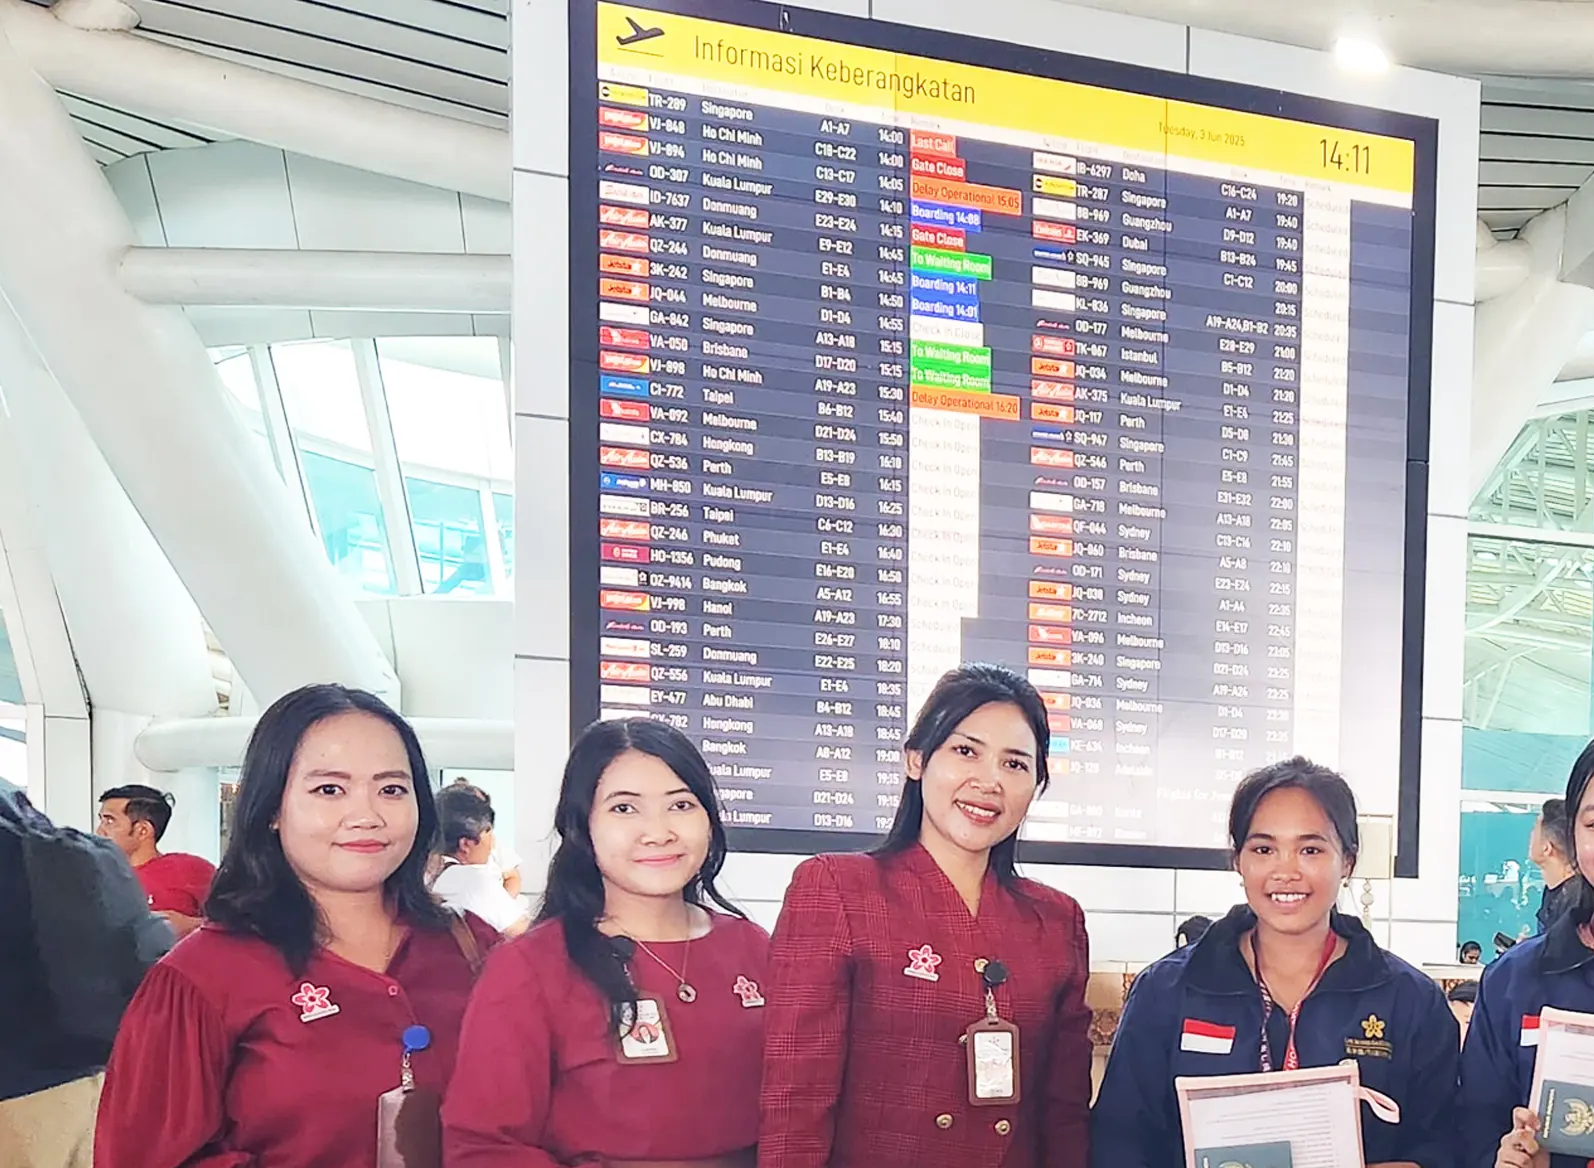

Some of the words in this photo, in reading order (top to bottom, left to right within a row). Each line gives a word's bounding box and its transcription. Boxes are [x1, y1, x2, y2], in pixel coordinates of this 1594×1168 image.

[695, 34, 803, 76] Informasi
[810, 54, 976, 104] Keberangkatan
[701, 100, 753, 121] Singapore
[820, 119, 850, 135] A1-A7
[878, 128, 903, 145] 14:00
[911, 133, 933, 150] Last
[934, 137, 953, 153] Call
[1199, 128, 1205, 140] 3
[1224, 132, 1245, 147] 2025
[702, 124, 717, 139] Ho
[718, 126, 736, 142] Chi
[736, 129, 762, 146] Minh
[878, 151, 903, 168] 14:00
[911, 157, 936, 173] Gate
[936, 161, 964, 177] Close
[1318, 136, 1370, 175] 14:11
[702, 148, 717, 163] Ho
[717, 150, 736, 166] Chi
[736, 153, 762, 170] Minh
[815, 165, 855, 184] C13-C17
[878, 175, 904, 191] 14:05
[912, 181, 939, 198] Delay
[940, 185, 994, 204] Operational
[996, 194, 1019, 209] 15:05
[1122, 167, 1145, 183] Doha
[1276, 191, 1298, 207] 19:20
[702, 172, 732, 189] Kuala
[733, 176, 773, 196] Lumpur
[879, 198, 903, 214] 14:10
[911, 202, 955, 225] Boarding
[955, 210, 980, 226] 14:08
[1121, 189, 1166, 209] Singapore
[1225, 206, 1252, 221] A1-A7
[702, 197, 757, 219] Donmuang
[879, 223, 903, 238] 14:15
[911, 227, 935, 243] Gate
[936, 231, 964, 248] Close
[1122, 212, 1172, 232] Guangzhou
[649, 213, 688, 231] AK-377
[702, 221, 732, 238] Kuala
[733, 225, 773, 243] Lumpur
[819, 237, 853, 255] E9-E12
[912, 251, 924, 265] To
[924, 253, 961, 272] Waiting
[962, 257, 990, 274] Room
[1122, 235, 1148, 251] Dubai
[702, 244, 757, 267] Donmuang
[821, 261, 850, 278] E1-E4
[910, 273, 955, 295] Boarding
[955, 280, 976, 295] 14:11
[1121, 258, 1167, 276] Singapore
[1223, 272, 1253, 289] C1-C12
[701, 268, 754, 288] Singapore
[820, 284, 851, 301] B1-B4
[878, 292, 903, 308] 14:50
[910, 295, 954, 317] Boarding
[955, 303, 978, 318] 14:01
[1121, 280, 1171, 299] Guangzhou
[702, 292, 757, 312] Melbourne
[878, 316, 903, 331] 14:55
[1121, 302, 1166, 321] Singapore
[1273, 324, 1297, 338] 20:35
[702, 316, 754, 336] Singapore
[879, 339, 902, 354] 15:15
[911, 343, 923, 357] To
[924, 345, 960, 364] Waiting
[961, 349, 989, 365] Room
[1121, 325, 1169, 343] Melbourne
[702, 340, 748, 359] Brisbane
[815, 354, 856, 372] D17-D20
[879, 362, 903, 378] 15:15
[911, 366, 923, 380] To
[923, 368, 960, 387] Waiting
[961, 372, 988, 387] Room
[1120, 347, 1158, 364] Istanbul
[702, 364, 718, 379] Ho
[718, 366, 736, 381] Chi
[737, 368, 762, 384] Minh
[814, 378, 856, 395] A19-A23
[878, 385, 903, 401] 15:30
[911, 390, 939, 406] Delay
[939, 394, 994, 410] Operational
[995, 400, 1018, 414] 16:20
[1120, 369, 1168, 388] Melbourne
[649, 382, 684, 399] CI-772
[702, 388, 734, 405] Taipei
[1120, 391, 1146, 407] Kuala
[1146, 395, 1182, 411] Lumpur
[1272, 410, 1294, 425] 21:25
[702, 411, 757, 430] Melbourne
[878, 431, 903, 447] 15:50
[1119, 414, 1145, 429] Perth
[702, 435, 754, 455] Hongkong
[816, 447, 855, 464] B13-B19
[1119, 436, 1165, 453] Singapore
[702, 459, 732, 474] Perth
[879, 477, 902, 492] 16:15
[1119, 458, 1144, 473] Perth
[1271, 475, 1293, 489] 21:55
[702, 482, 733, 498] Kuala
[733, 485, 773, 503] Lumpur
[815, 493, 855, 510] D13-D16
[877, 500, 903, 515] 16:25
[1119, 480, 1158, 496] Brisbane
[702, 506, 734, 523] Taipei
[817, 517, 853, 533] C6-C12
[878, 523, 902, 538] 16:30
[1118, 502, 1166, 519] Melbourne
[702, 529, 740, 546] Phuket
[821, 541, 850, 556] E1-E4
[1118, 524, 1151, 541] Sydney
[702, 553, 741, 571] Pudong
[1118, 546, 1158, 562] Brisbane
[702, 576, 747, 593] Bangkok
[816, 586, 852, 602] A5-A12
[1117, 568, 1150, 585] Sydney
[1117, 590, 1150, 606] Sydney
[702, 600, 733, 615] Hanoi
[813, 609, 855, 625] A19-A23
[877, 614, 902, 628] 17:30
[1117, 611, 1153, 626] Incheon
[702, 622, 732, 638] Perth
[1116, 633, 1164, 649] Melbourne
[702, 646, 757, 665] Donmuang
[702, 670, 732, 684] Kuala
[733, 672, 773, 689] Lumpur
[702, 693, 723, 707] Abu
[724, 694, 753, 709] Dhabi
[702, 716, 753, 734] Hongkong
[701, 739, 747, 755] Bangkok
[733, 764, 772, 780] Lumpur
[876, 772, 899, 785] 19:15
